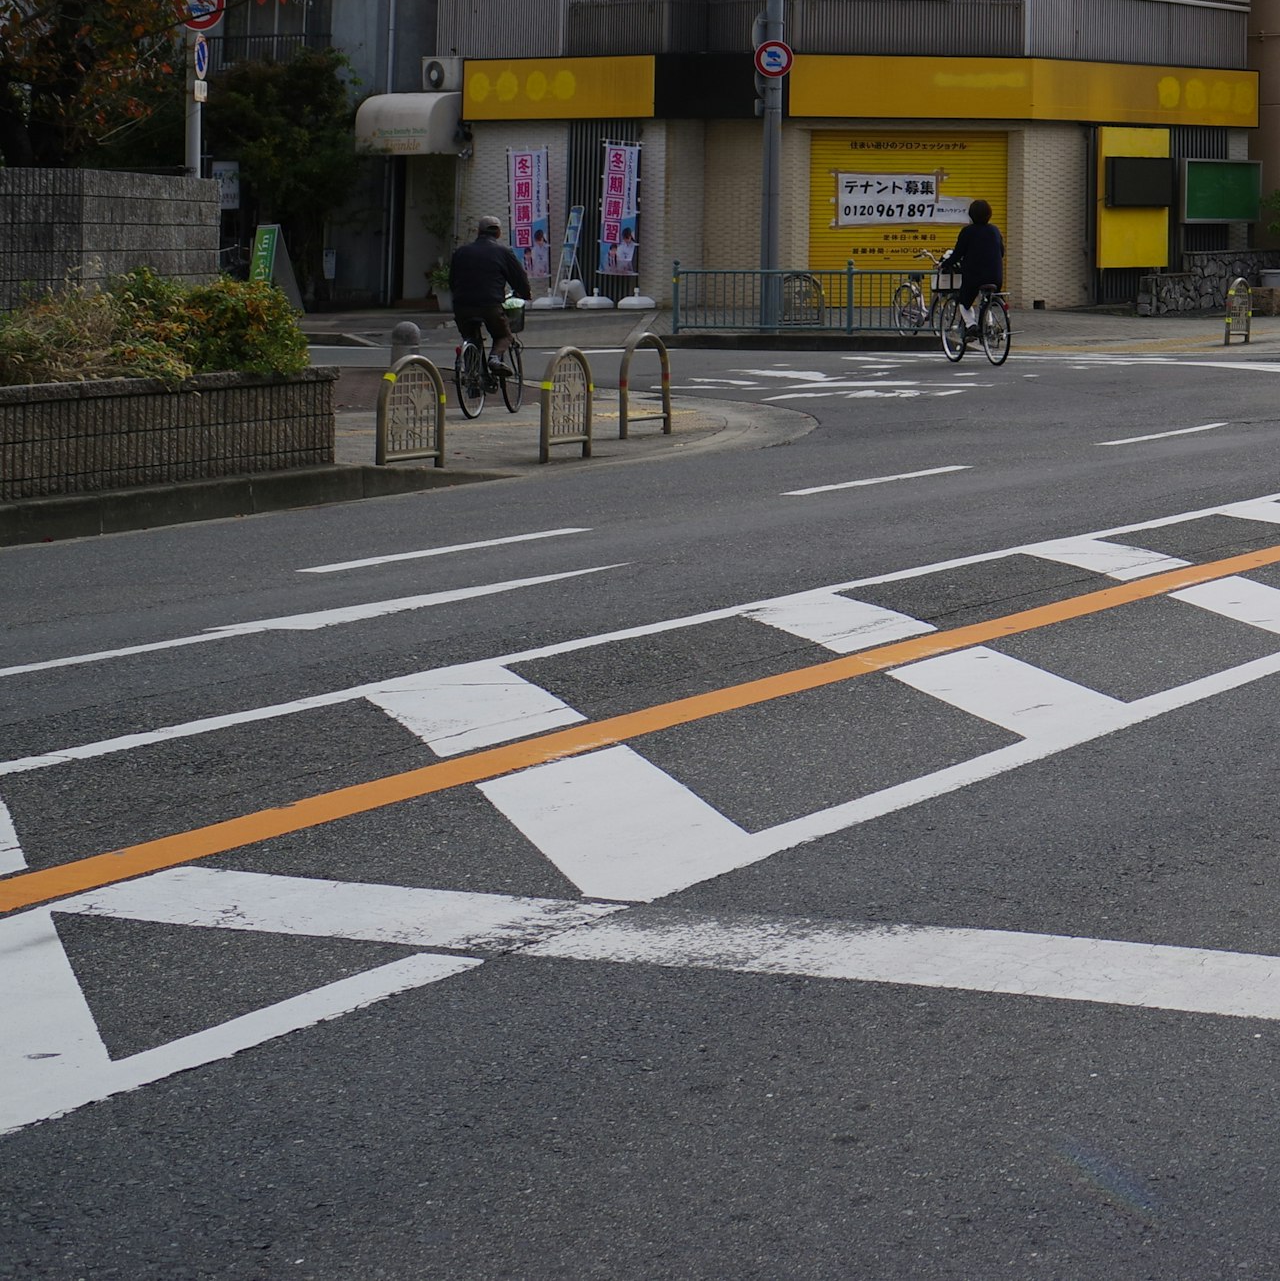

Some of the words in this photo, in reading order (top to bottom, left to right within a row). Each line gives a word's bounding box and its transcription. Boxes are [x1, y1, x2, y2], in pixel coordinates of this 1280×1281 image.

[516, 156, 532, 247] 冬期講習
[606, 151, 624, 243] 冬期講習
[844, 180, 935, 196] テナント募集
